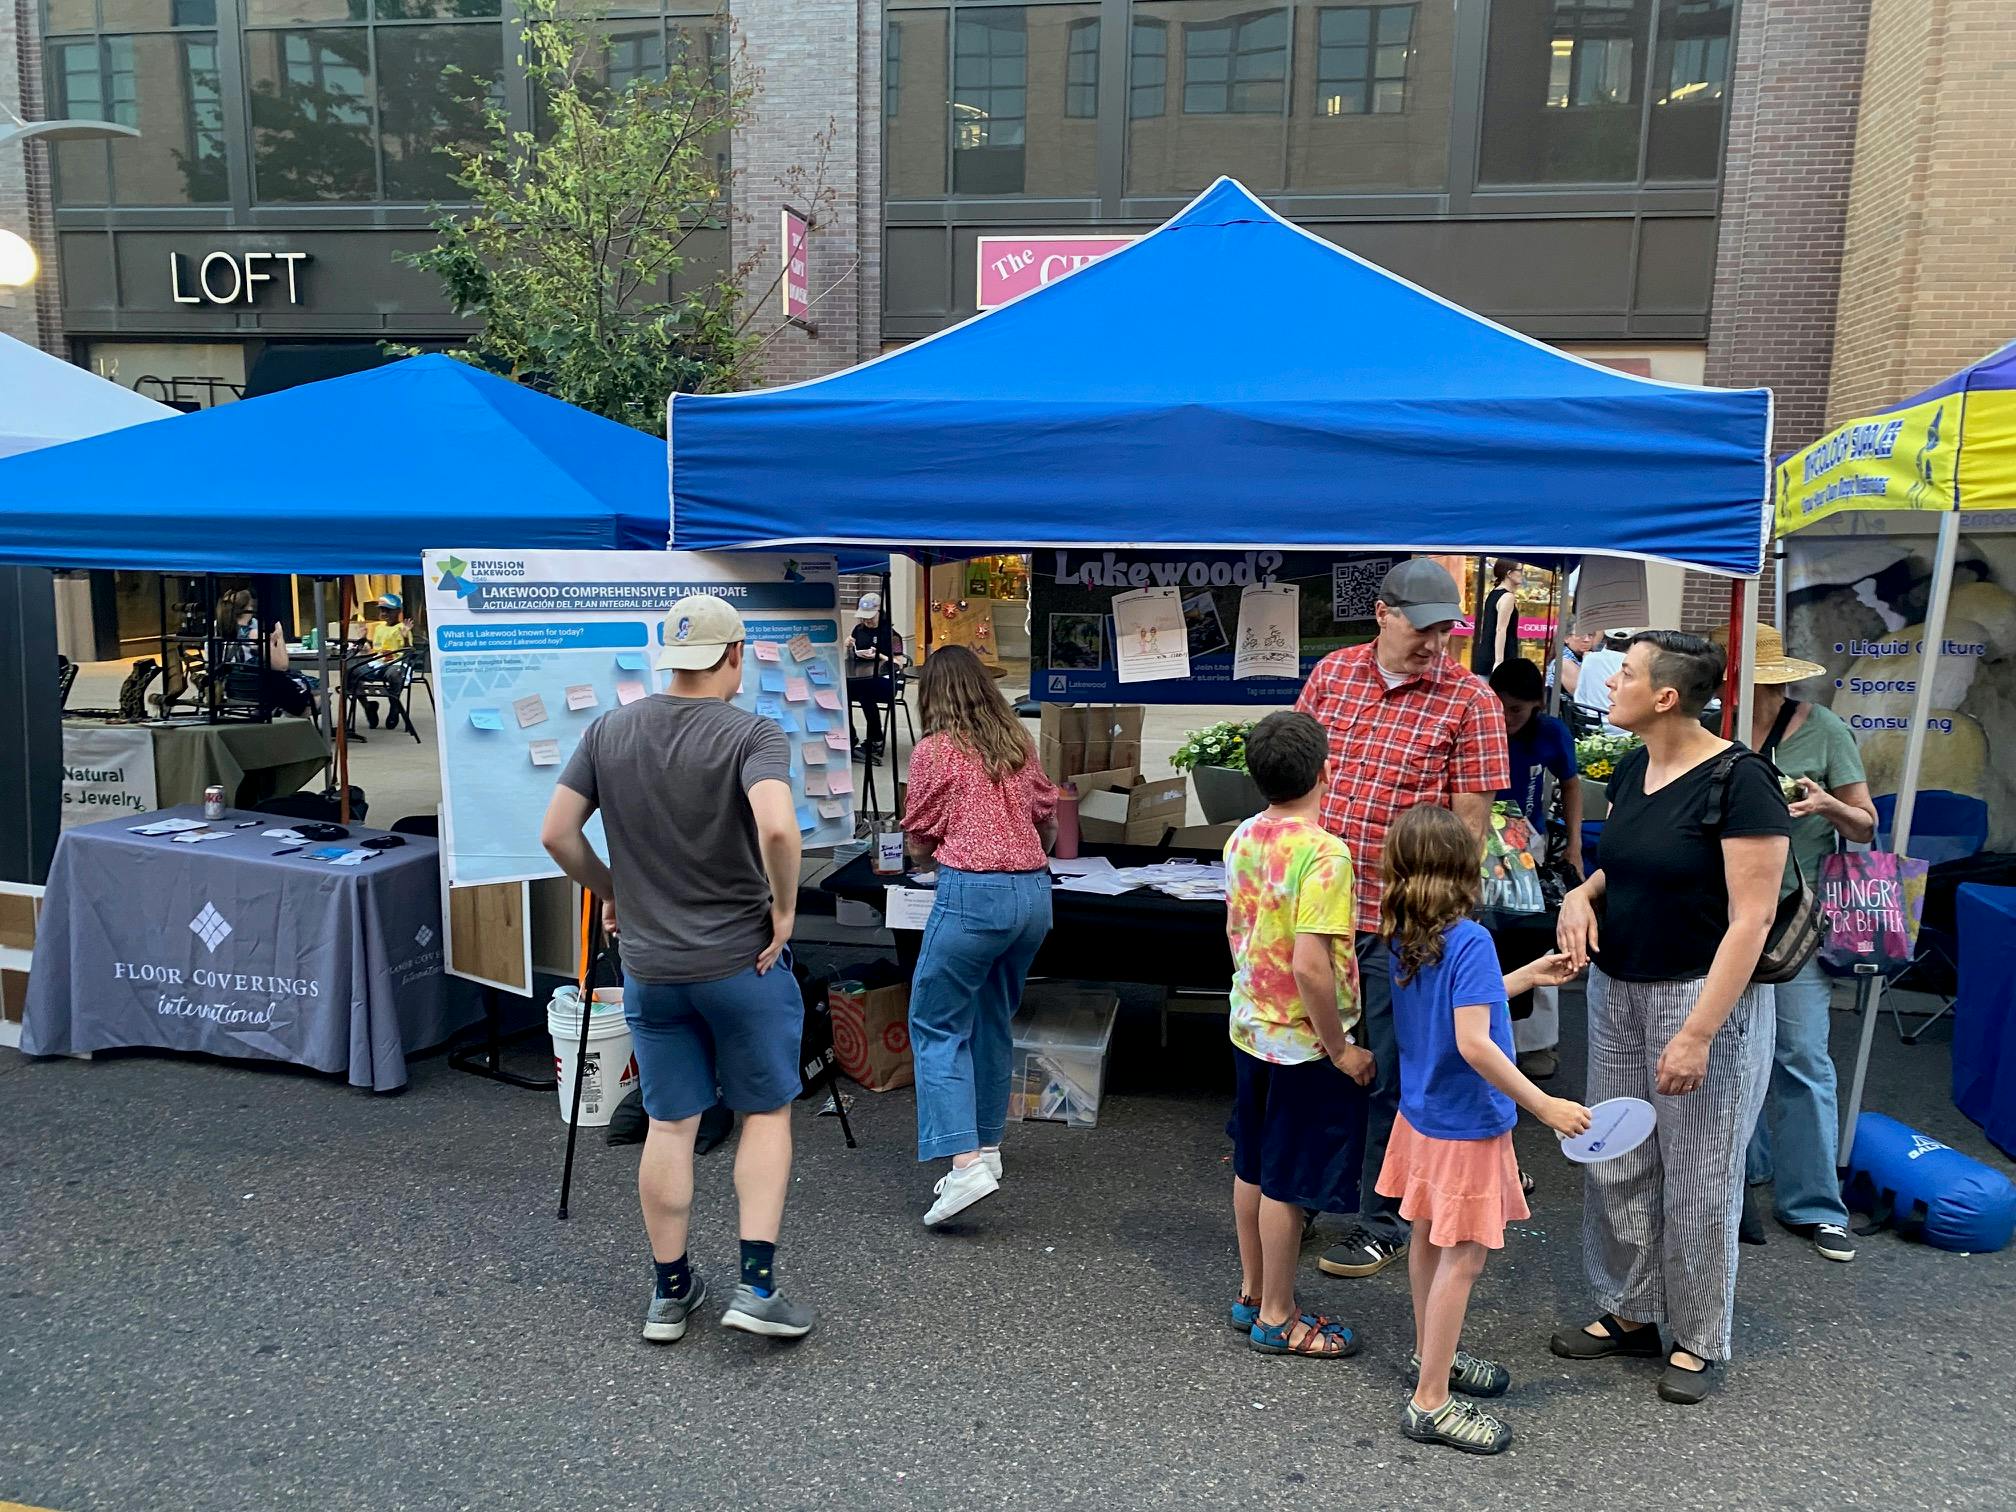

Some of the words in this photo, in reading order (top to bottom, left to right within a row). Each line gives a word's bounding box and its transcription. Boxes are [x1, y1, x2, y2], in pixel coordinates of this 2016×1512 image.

[991, 249, 1035, 281] The
[170, 251, 307, 304] LOFT
[471, 560, 525, 569] ENVISION
[1055, 550, 1283, 587] Lakewood?
[482, 587, 559, 598] LAKEWOOD
[562, 586, 667, 597] COMPREHENSIVE
[669, 586, 699, 597] PLAN
[703, 586, 748, 597] UPDATE
[483, 599, 555, 609] ACTUALIZACIÓN
[557, 600, 572, 608] DEL
[574, 600, 598, 608] PLAN
[599, 600, 640, 608] INTEGRAL
[642, 600, 652, 608] DE
[654, 600, 676, 608] LAKE
[467, 630, 474, 638] is
[476, 629, 517, 638] Lakewood
[518, 629, 544, 637] known
[546, 628, 557, 636] for
[559, 628, 584, 638] today?
[514, 638, 547, 646] Lakewood
[1850, 640, 1910, 658] Liquid
[1916, 640, 1985, 656] Clture
[1850, 678, 1916, 695] Spores
[1850, 714, 1953, 733] Consung
[62, 766, 124, 783] Natural
[78, 790, 142, 810] Jewelry
[1826, 879, 1899, 909] HUNGRY
[1856, 909, 1905, 933] BETTER
[113, 962, 184, 984] FLOOR
[193, 969, 319, 997] COVERINGS
